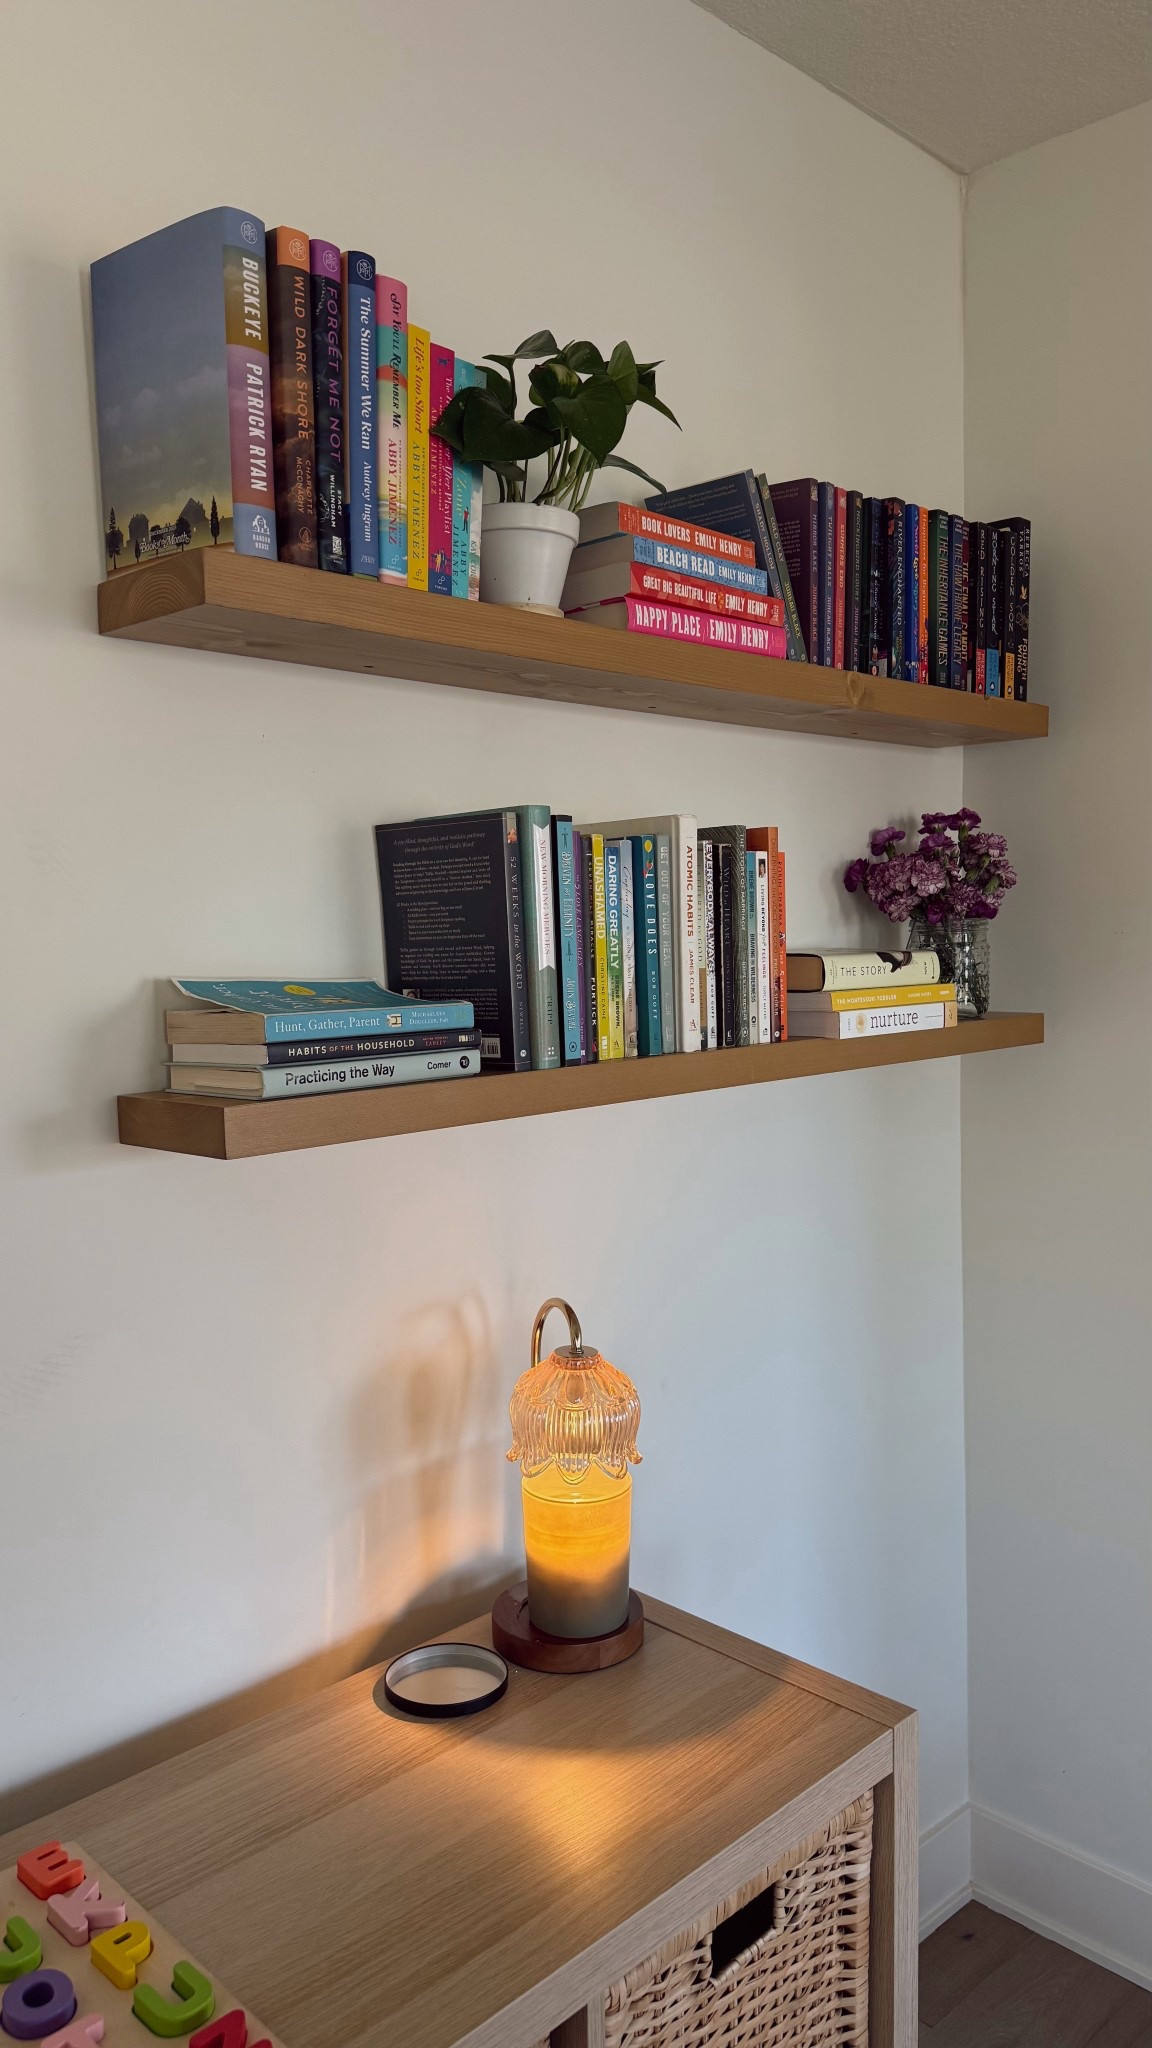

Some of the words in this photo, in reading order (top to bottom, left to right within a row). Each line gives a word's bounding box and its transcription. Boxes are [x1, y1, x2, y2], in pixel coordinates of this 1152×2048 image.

[242, 257, 261, 341] BUCKEYE
[294, 276, 304, 318] WILD
[360, 297, 372, 324] The
[327, 287, 339, 372] FORGET
[296, 328, 306, 374] DARK
[360, 330, 372, 391] Summer
[413, 338, 424, 371] Life's
[246, 362, 266, 440] PATRICK
[329, 379, 339, 408] ME
[390, 354, 401, 409] REMEMBER
[415, 377, 423, 393] too
[296, 381, 309, 440] SHORE
[361, 396, 372, 418] We
[415, 397, 423, 433] Short
[330, 418, 341, 463] NOT
[361, 422, 372, 450] Ran
[250, 445, 267, 492] RYAN
[388, 439, 397, 477] ABBY
[413, 442, 421, 479] ABBY
[363, 461, 372, 500] Audrey
[362, 504, 372, 542] Ingram
[388, 480, 397, 545] JIMENEZ
[413, 490, 421, 559] JIMENEZ
[642, 515, 662, 534] BOOK
[664, 524, 690, 543] LOVERS
[695, 532, 716, 549] EMILY
[720, 541, 742, 557] HENRY
[756, 502, 766, 533] SHADY
[763, 536, 775, 570] HOLLOW
[940, 536, 948, 554] THE
[657, 547, 688, 570] BEACH
[691, 557, 714, 576] READ
[718, 565, 736, 580] EMILY
[738, 571, 755, 585] HENRY
[770, 517, 778, 539] COLD
[775, 542, 784, 562] CLAY
[791, 614, 800, 639] BLACK
[643, 576, 660, 590] GREAT
[662, 580, 672, 593] BIG
[675, 583, 703, 601] BEAUTIFUL
[705, 593, 716, 605] LIFE
[725, 597, 744, 612] EMILY
[747, 601, 768, 617] HENRY
[938, 558, 948, 625] INHERITANCE
[953, 564, 962, 623] HAWTHORNE
[635, 604, 667, 630] HAPPY
[671, 612, 701, 637] PLACE
[710, 620, 737, 643] EMILY
[741, 625, 769, 649] HENRY
[938, 628, 948, 665] GAMES
[953, 626, 962, 664] LEGACY
[510, 856, 517, 868] 52
[661, 847, 669, 865] GET
[511, 874, 520, 918] WEEKS
[594, 857, 605, 939] UNASHAMED
[608, 856, 618, 906] DARING
[646, 873, 655, 909] LOVE
[662, 894, 669, 905] OF
[740, 879, 745, 889] OF
[543, 912, 552, 956] MERCIES
[564, 898, 573, 938] ETERNITY
[647, 918, 656, 954] DOES
[610, 910, 620, 968] GREATLY
[663, 941, 672, 966] HEAD
[706, 923, 715, 970] ALWAYS
[840, 966, 856, 976] THE
[860, 966, 887, 975] STORY
[275, 1021, 305, 1033] Hunt,
[309, 1018, 348, 1031] Gather,
[350, 1016, 380, 1028] Parent
[871, 1012, 918, 1028] nurture
[288, 1046, 327, 1056] HABITS
[357, 1039, 415, 1050] HOUSEHOLD
[285, 1069, 346, 1086] Practicing
[350, 1066, 369, 1080] the
[372, 1064, 394, 1077] Way
[427, 1060, 451, 1070] Comer
[17, 1840, 85, 1900] E
[47, 1877, 126, 1946] K
[91, 1921, 151, 1989] P
[2, 1969, 76, 2040] O
[134, 1960, 214, 2037] U
